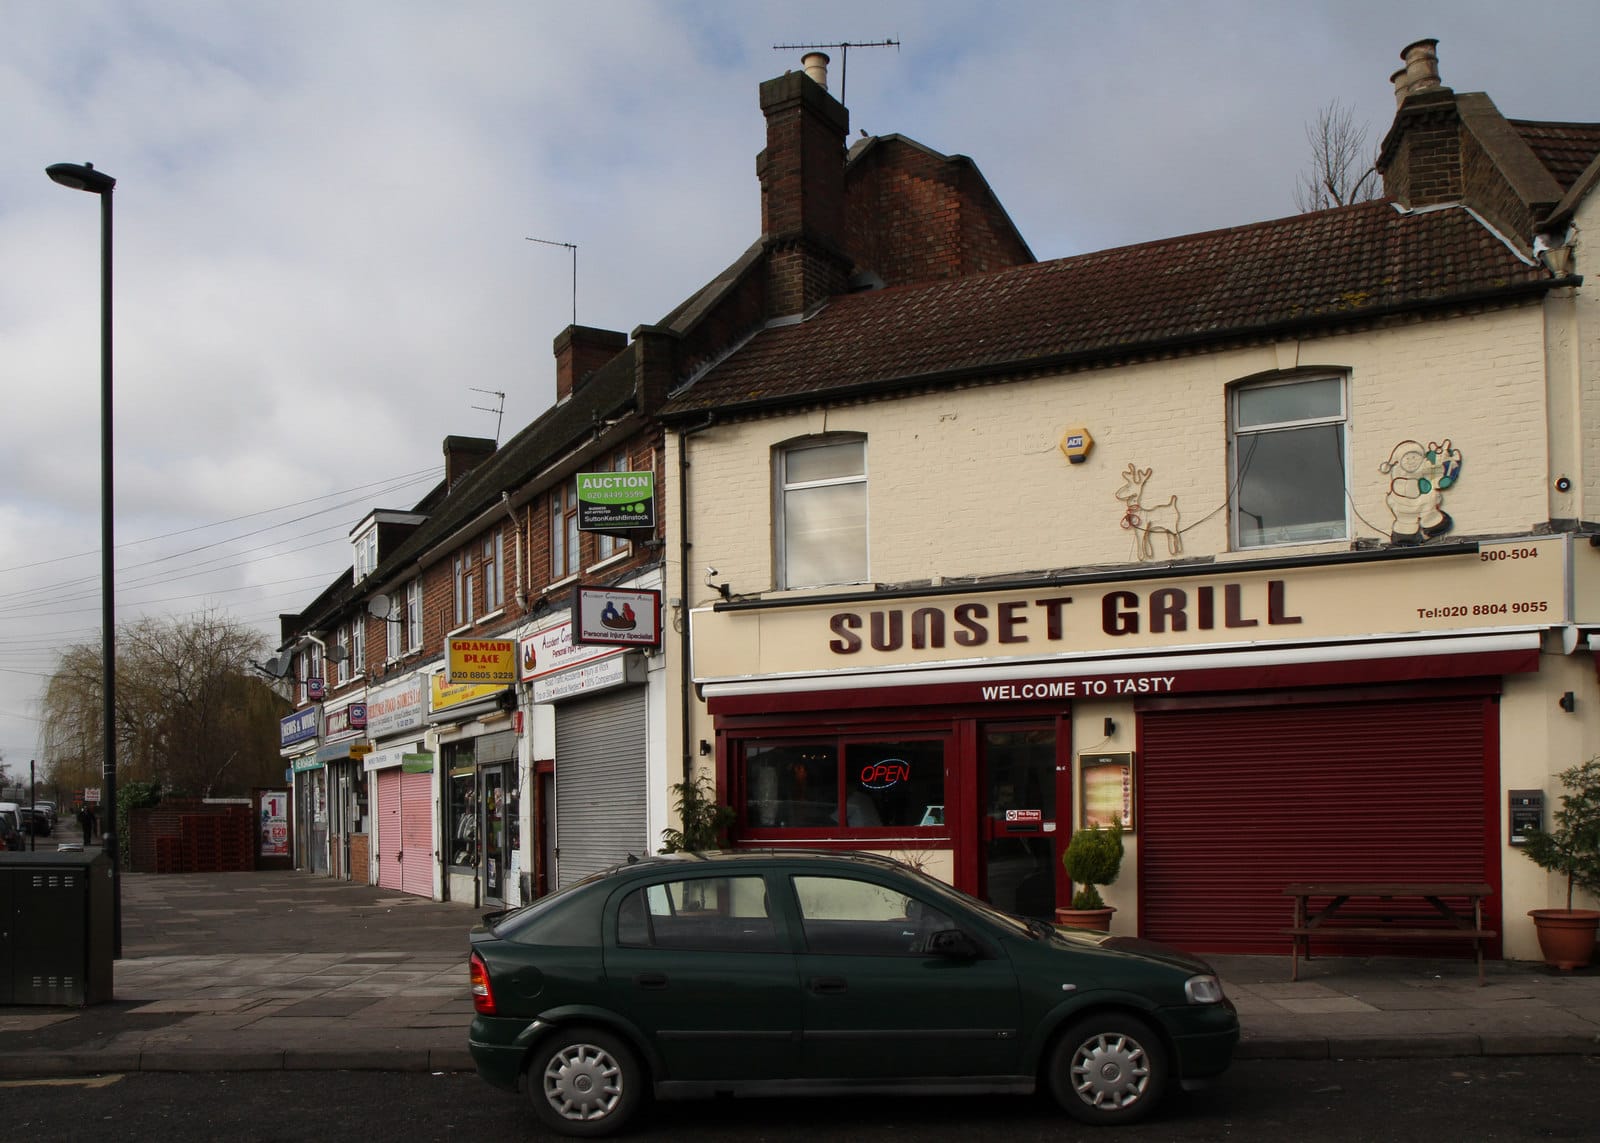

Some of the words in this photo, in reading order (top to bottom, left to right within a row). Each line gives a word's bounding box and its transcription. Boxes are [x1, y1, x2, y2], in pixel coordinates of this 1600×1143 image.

[1068, 438, 1083, 446] ADT
[583, 476, 648, 489] AUCTION
[1480, 547, 1538, 562] 500-504
[1417, 605, 1468, 619] Tel:020
[1473, 603, 1508, 616] 8804
[1511, 600, 1548, 614] 9055
[829, 597, 1073, 655] SUNSET
[1102, 580, 1302, 637] GRILL
[583, 630, 608, 638] Personal
[610, 631, 626, 640] Injury
[452, 641, 511, 651] GRAMADI
[464, 654, 499, 663] PLACE
[552, 648, 567, 659] Personal
[596, 671, 623, 684] Compensation
[982, 682, 1076, 701] WELCOME
[1081, 680, 1107, 695] TO
[1113, 676, 1175, 693] TASTY
[861, 765, 910, 783] OPEN
